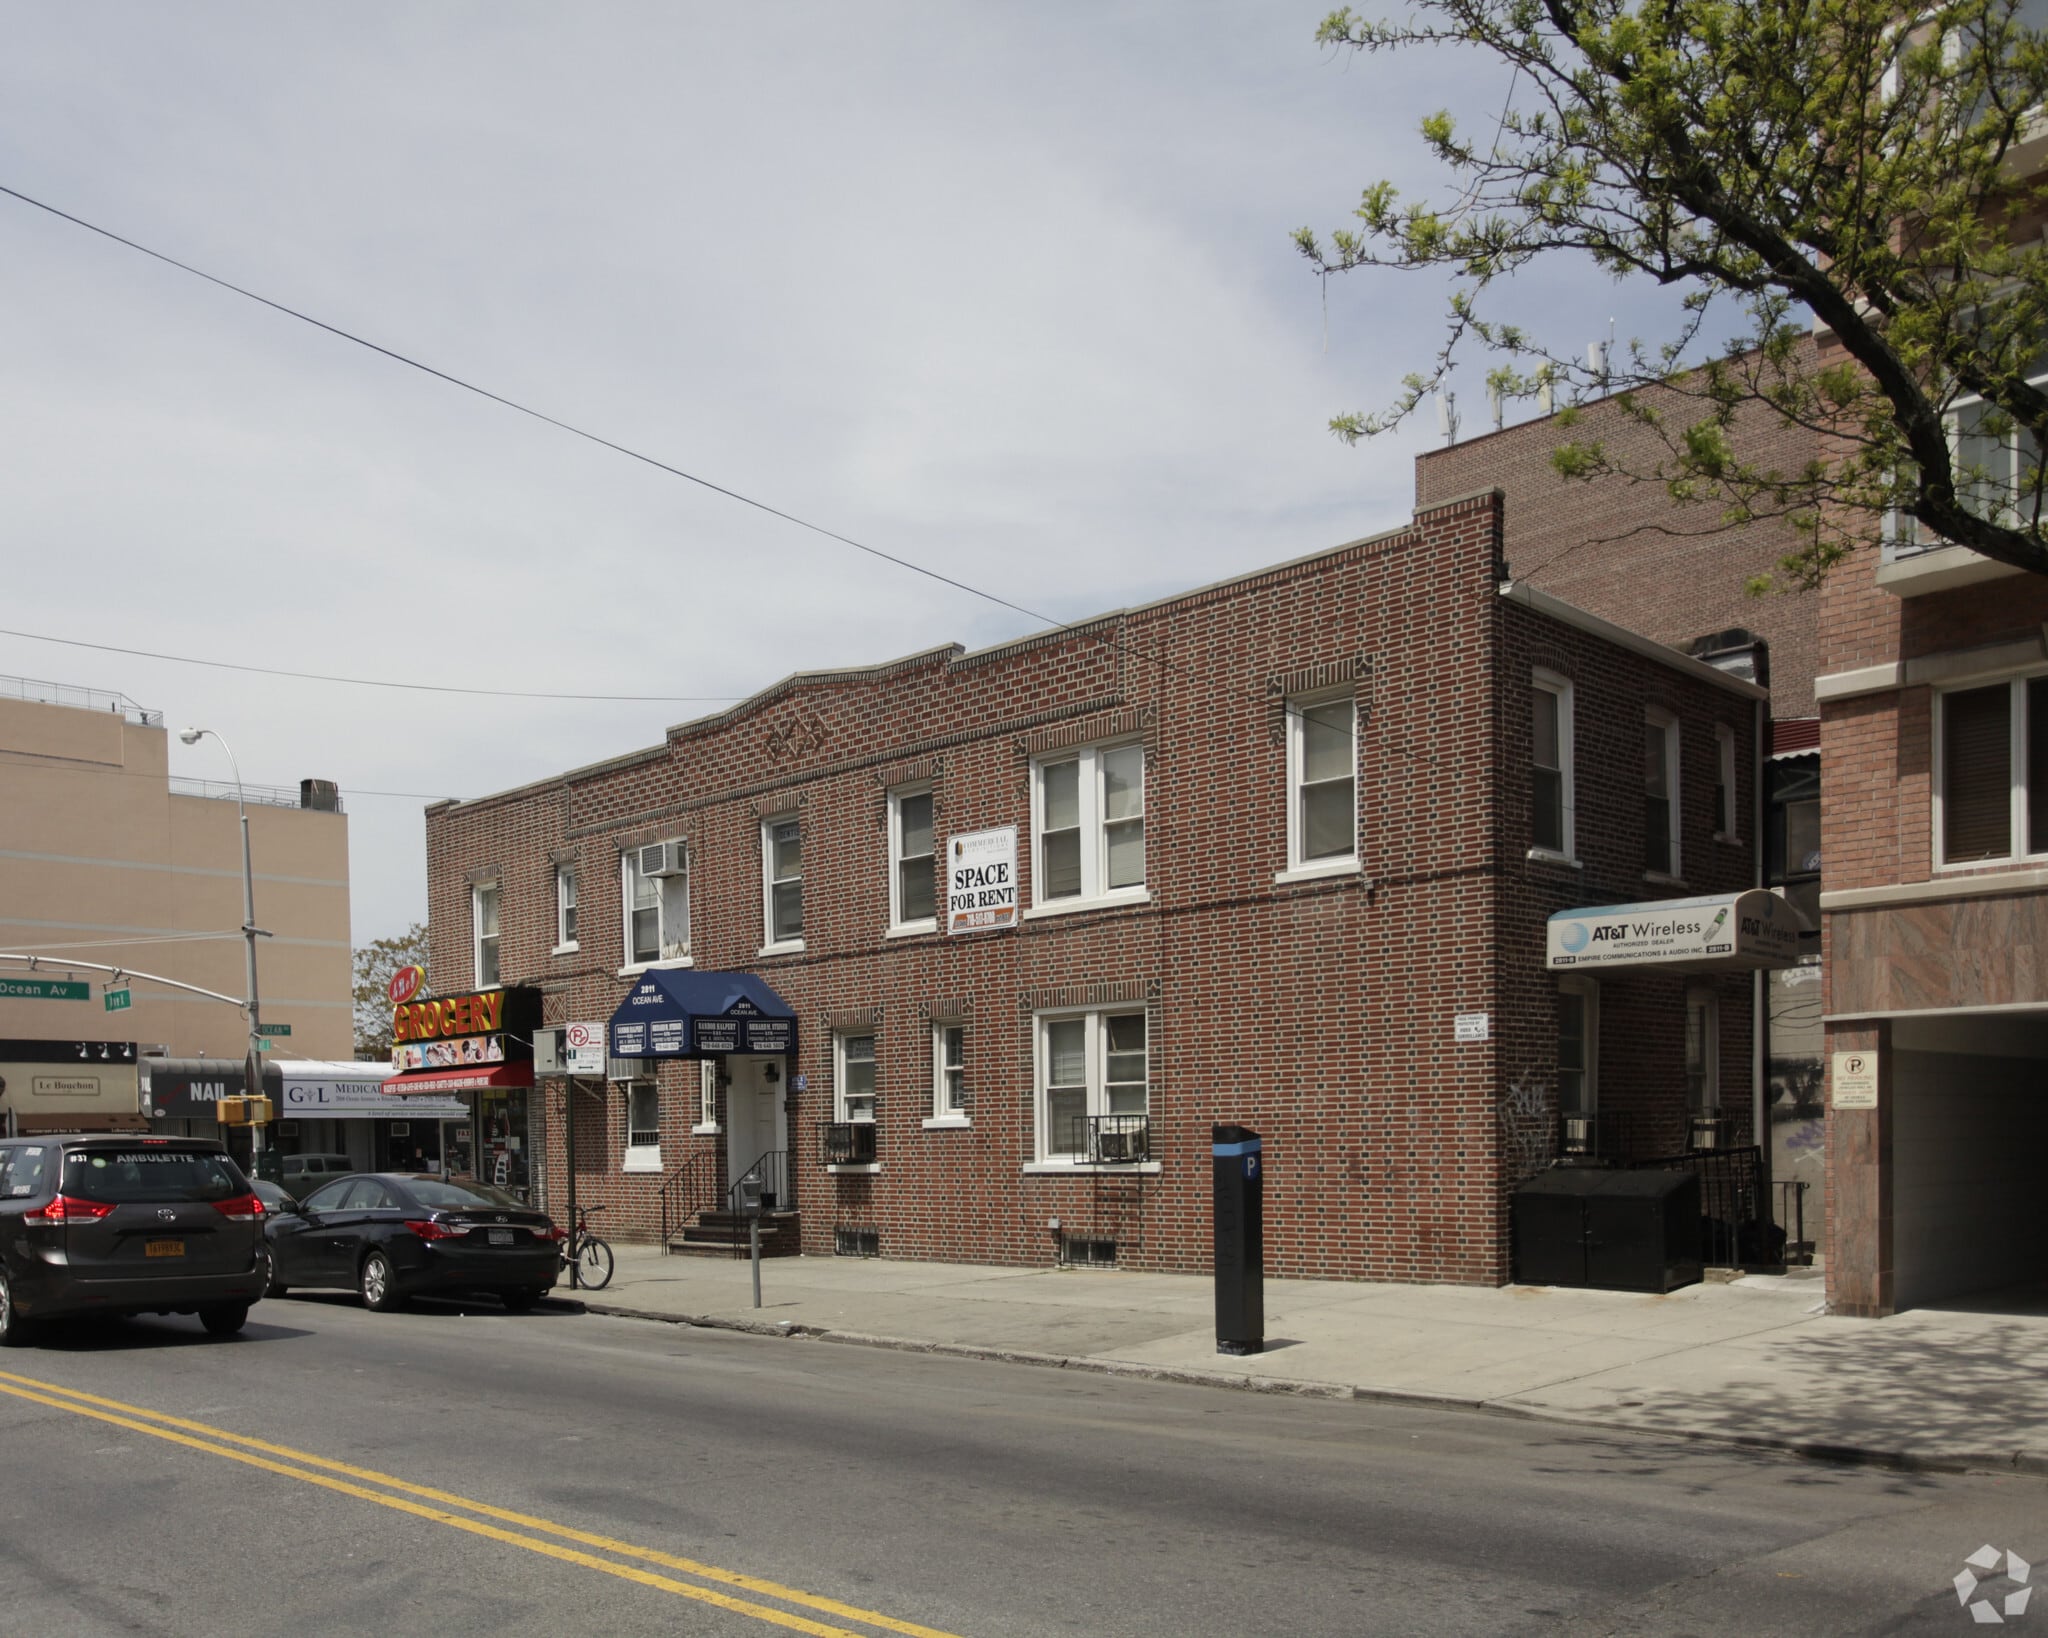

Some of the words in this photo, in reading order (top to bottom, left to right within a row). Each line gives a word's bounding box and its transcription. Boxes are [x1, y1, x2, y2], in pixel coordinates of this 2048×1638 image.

[955, 863, 1009, 890] SPACE
[950, 893, 975, 911] FOR
[978, 887, 1014, 908] RENT
[1592, 924, 1628, 942] AT&T
[1632, 921, 1701, 938] Wireless
[1651, 938, 1674, 946] DEALER
[1602, 951, 1660, 961] COMMUNICATIONS
[0, 982, 41, 995] Ocean
[50, 984, 67, 996] Av
[632, 996, 651, 1005] OCEAN
[394, 991, 502, 1041] GROCERY
[54, 1081, 94, 1089] Bouchon
[190, 1082, 226, 1101] NAIL
[289, 1086, 304, 1103] G
[318, 1087, 330, 1103] L
[70, 1154, 87, 1163] #37
[116, 1154, 195, 1164] AMBULETTE
[1247, 1156, 1256, 1177] P
